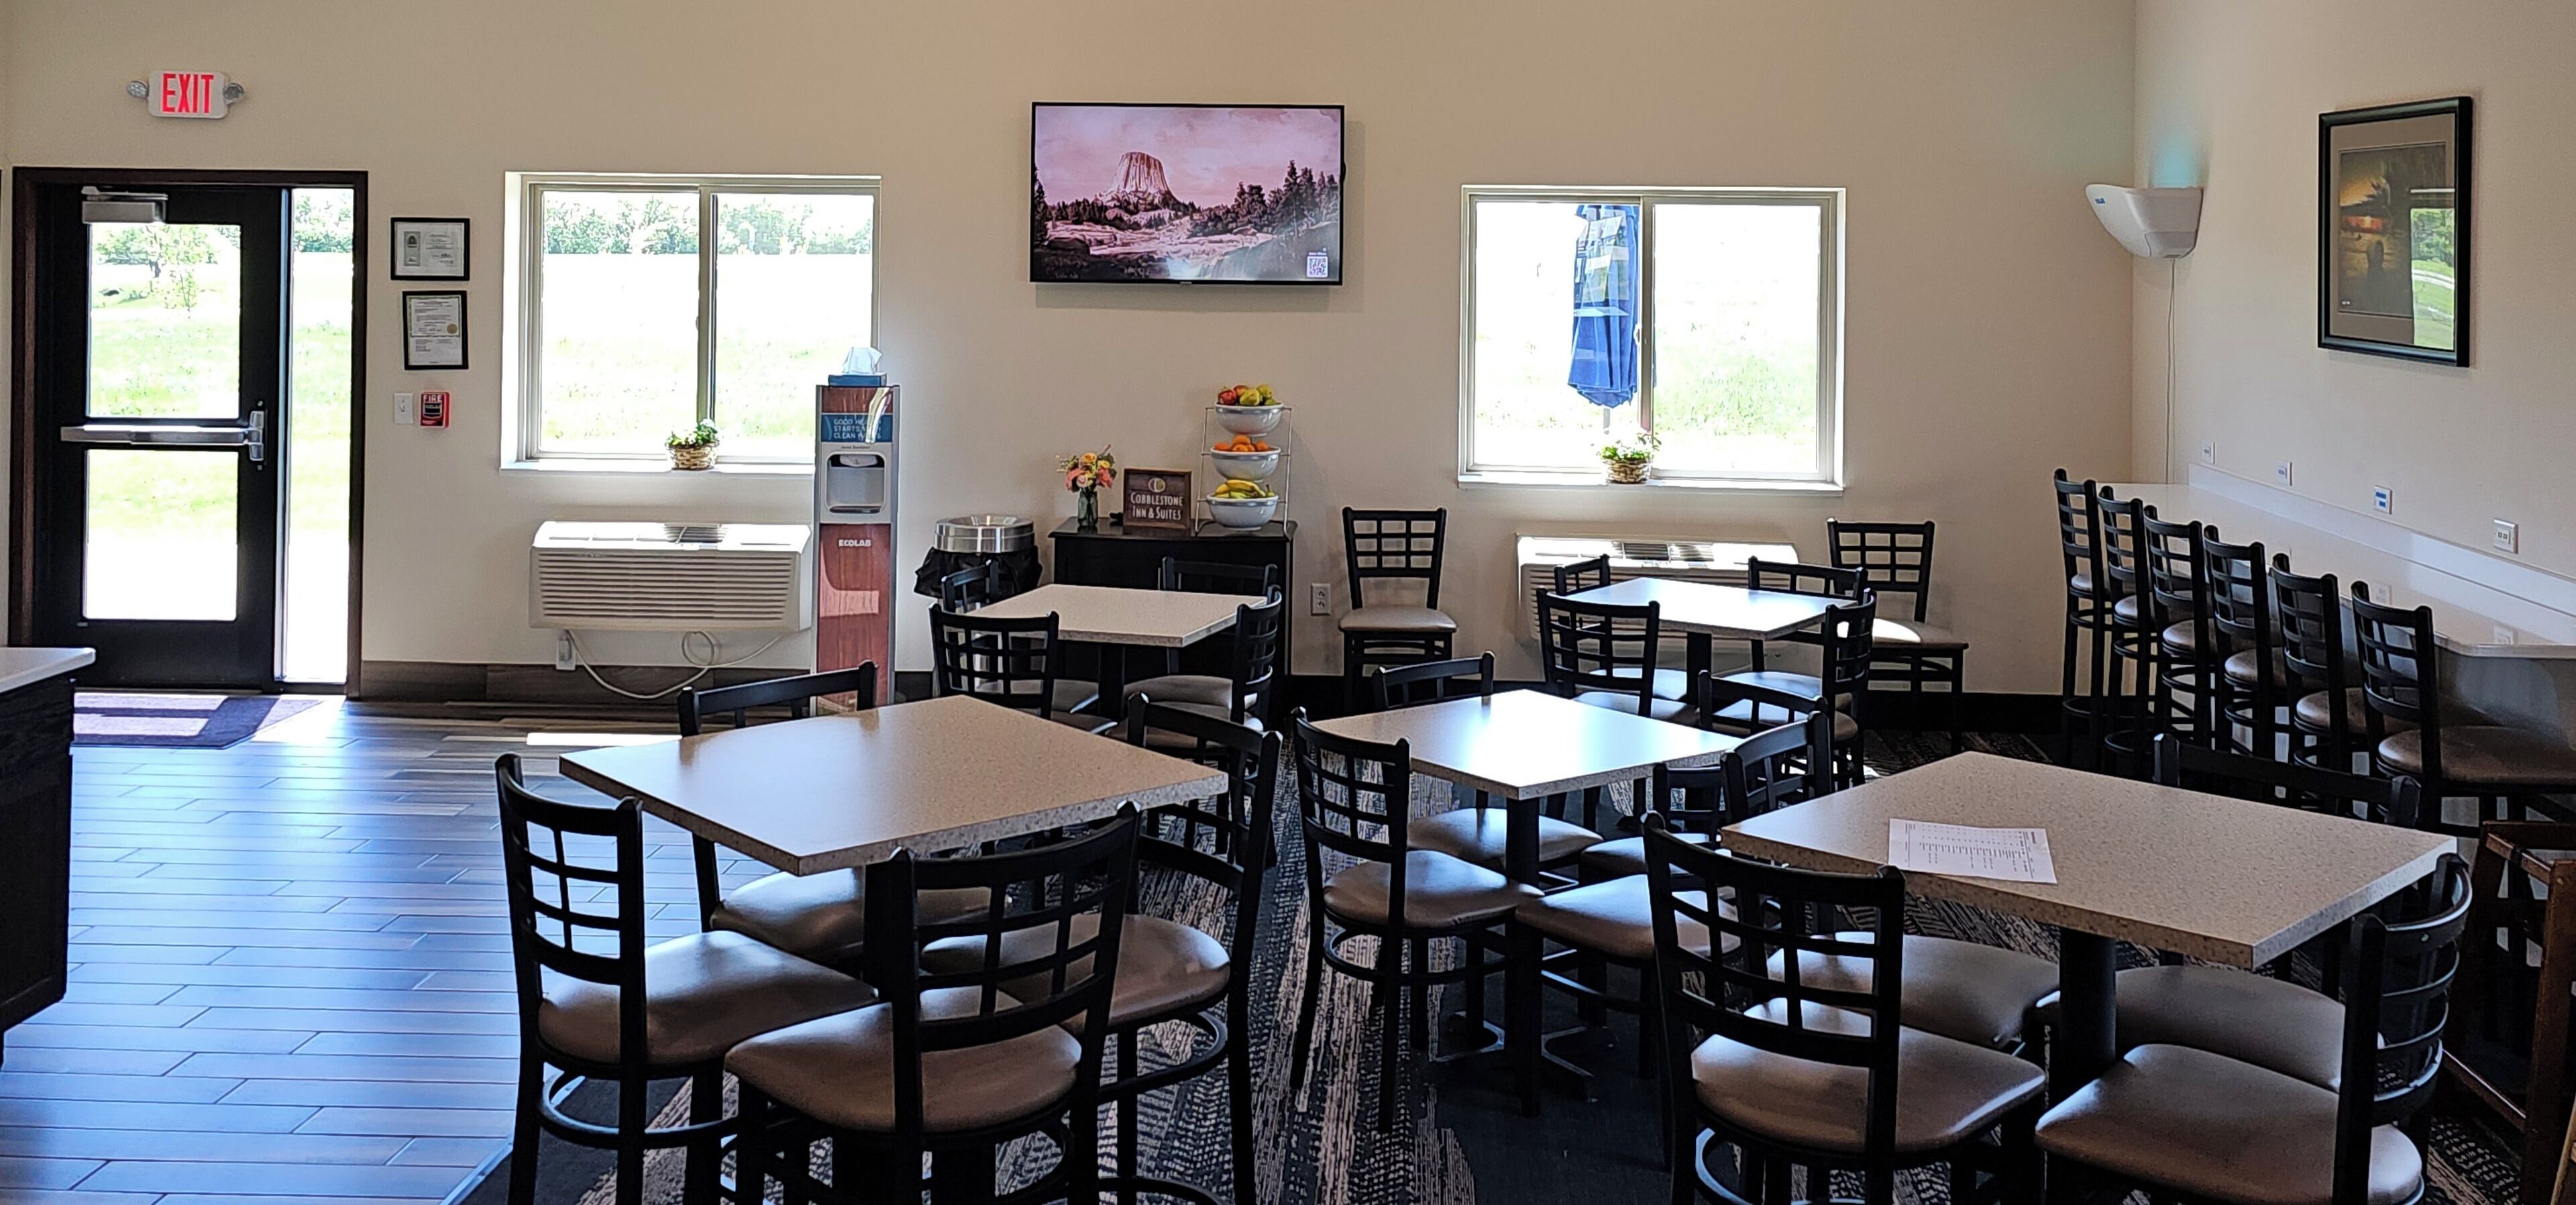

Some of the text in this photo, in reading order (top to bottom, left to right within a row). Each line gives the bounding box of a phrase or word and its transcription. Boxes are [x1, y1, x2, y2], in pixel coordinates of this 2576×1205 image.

[162, 73, 214, 113] EXIT
[423, 394, 442, 403] FIRE
[1148, 507, 1155, 519] &
